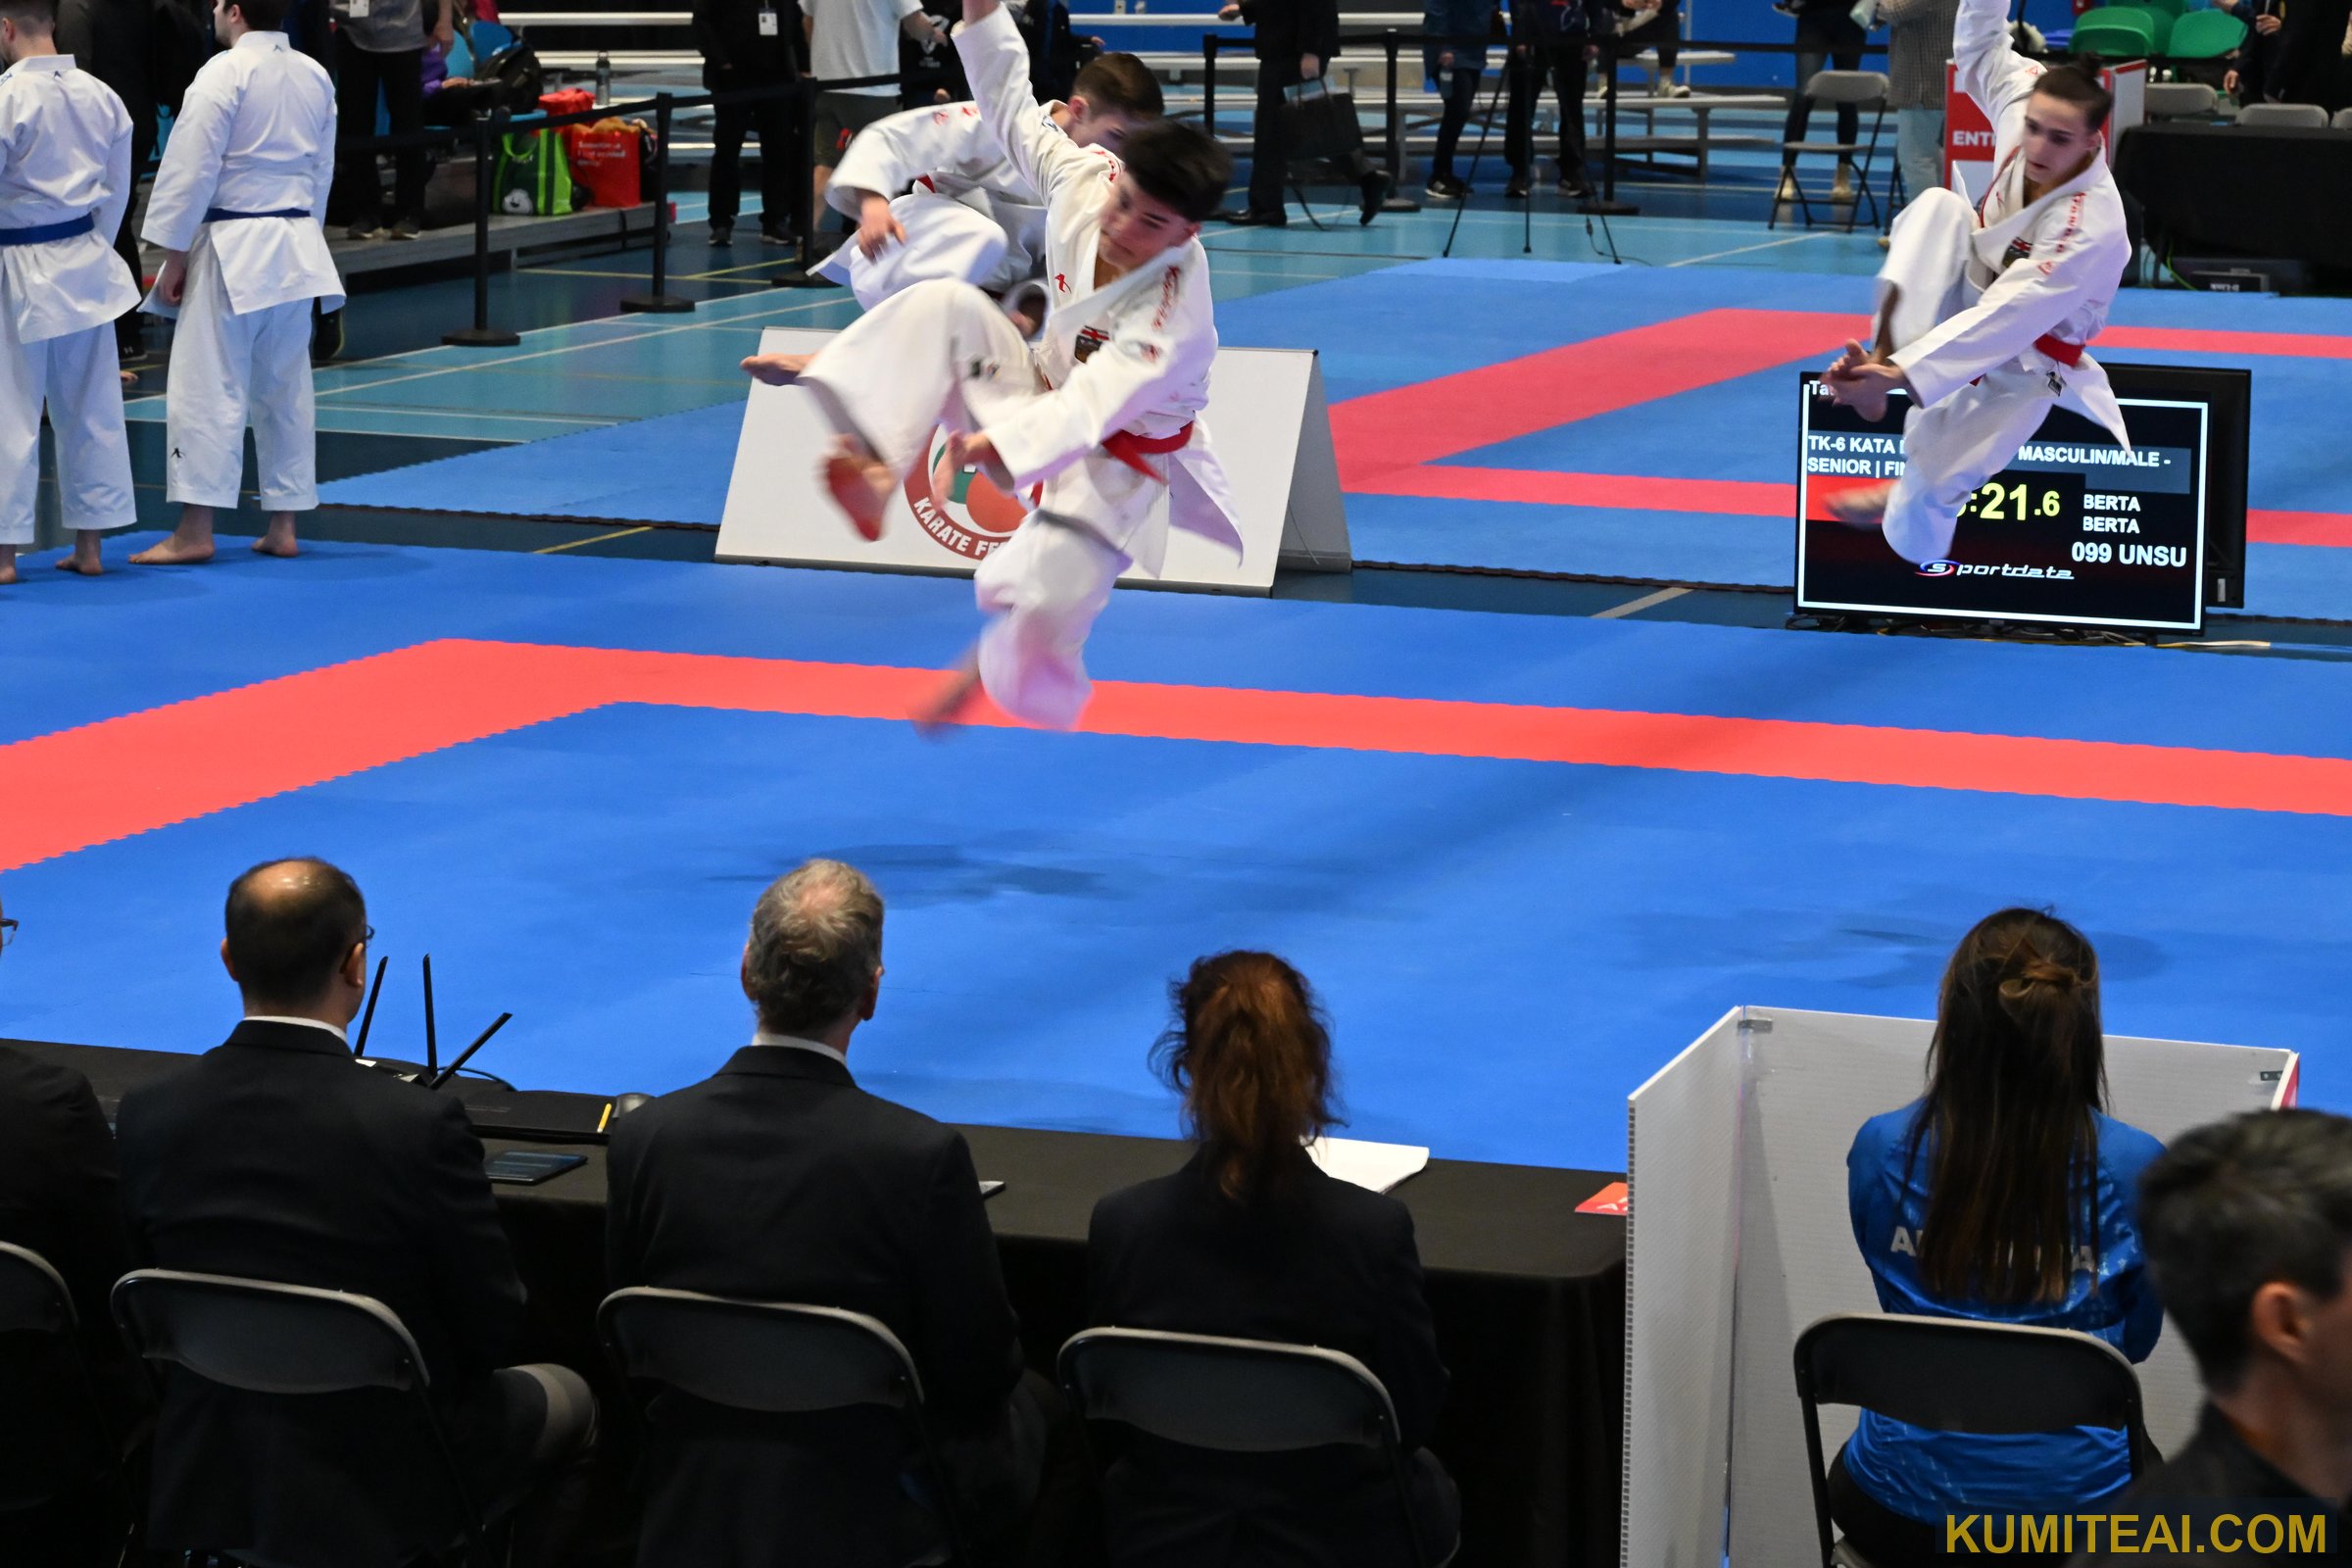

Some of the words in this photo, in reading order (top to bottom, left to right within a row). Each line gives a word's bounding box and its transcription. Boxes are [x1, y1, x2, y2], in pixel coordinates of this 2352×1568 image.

[1809, 380, 1832, 396] Ta
[1808, 435, 1846, 452] TK-6
[1849, 437, 1896, 454] KATA
[2018, 446, 2160, 467] MASCULIN/MALE
[1807, 457, 1872, 475] SENIOR
[1957, 482, 2061, 520] :21.6
[2083, 494, 2141, 512] BERTA
[913, 497, 972, 553] KARATE
[2082, 516, 2140, 534] BERTA
[2071, 541, 2113, 564] 099
[2119, 544, 2187, 567] UNSU
